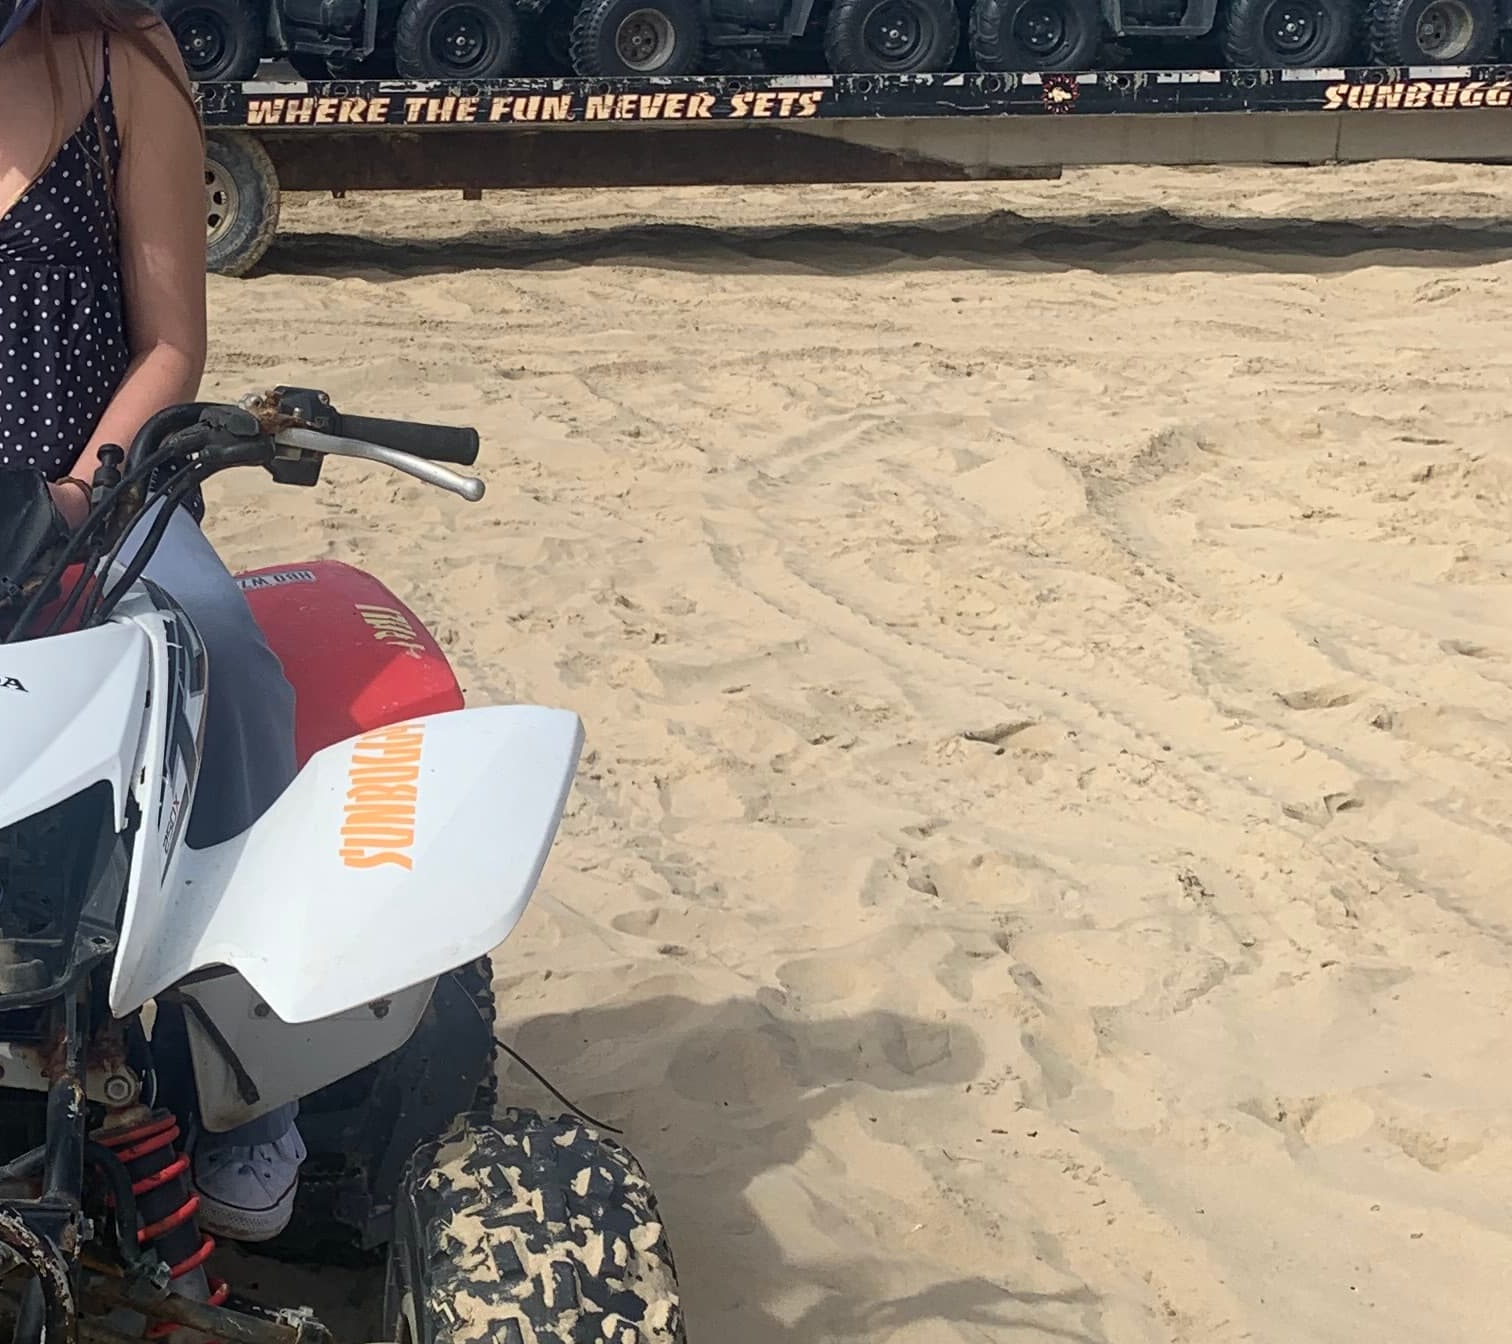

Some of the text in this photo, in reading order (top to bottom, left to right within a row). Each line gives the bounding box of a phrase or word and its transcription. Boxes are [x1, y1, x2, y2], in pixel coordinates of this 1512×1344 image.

[246, 90, 825, 125] WHERE THE FUN NEVER SETS
